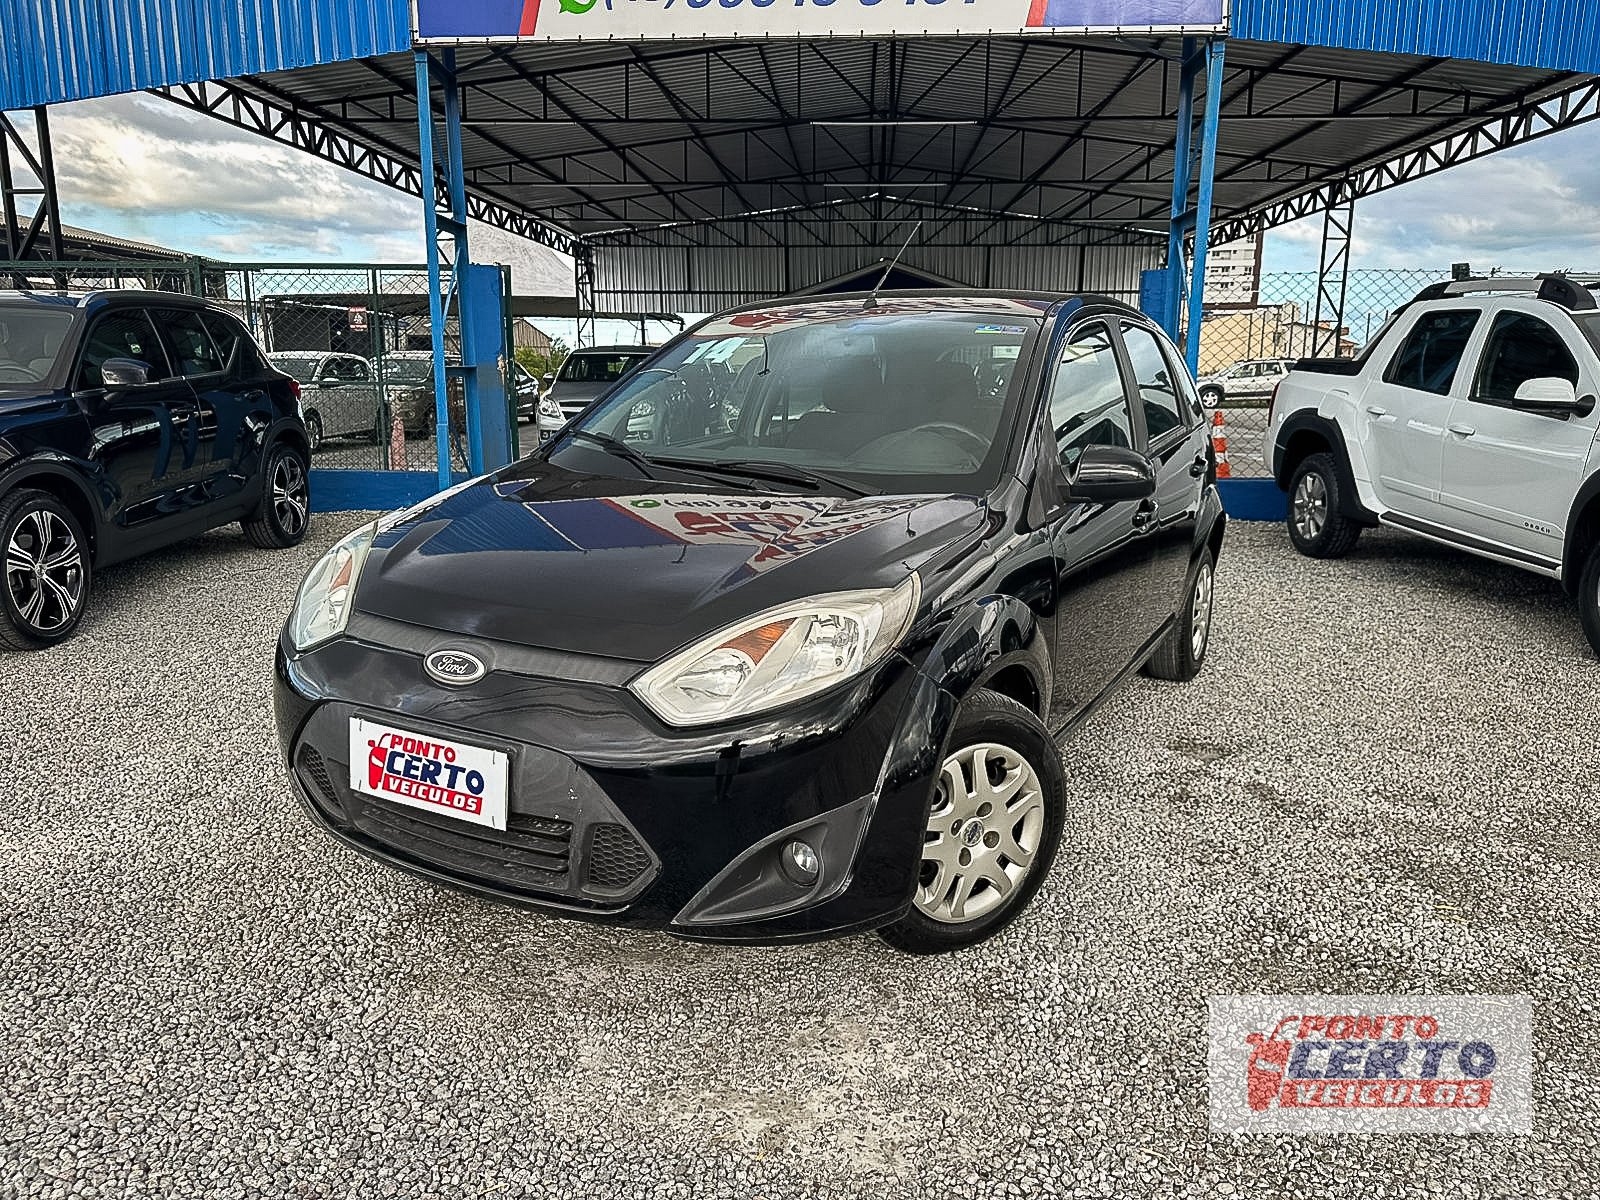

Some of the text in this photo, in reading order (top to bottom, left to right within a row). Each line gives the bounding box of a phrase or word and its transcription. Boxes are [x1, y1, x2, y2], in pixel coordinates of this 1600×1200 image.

[681, 337, 744, 364] 14
[438, 656, 469, 674] Ford
[390, 734, 456, 762] PONTO
[386, 751, 485, 795] CERTO
